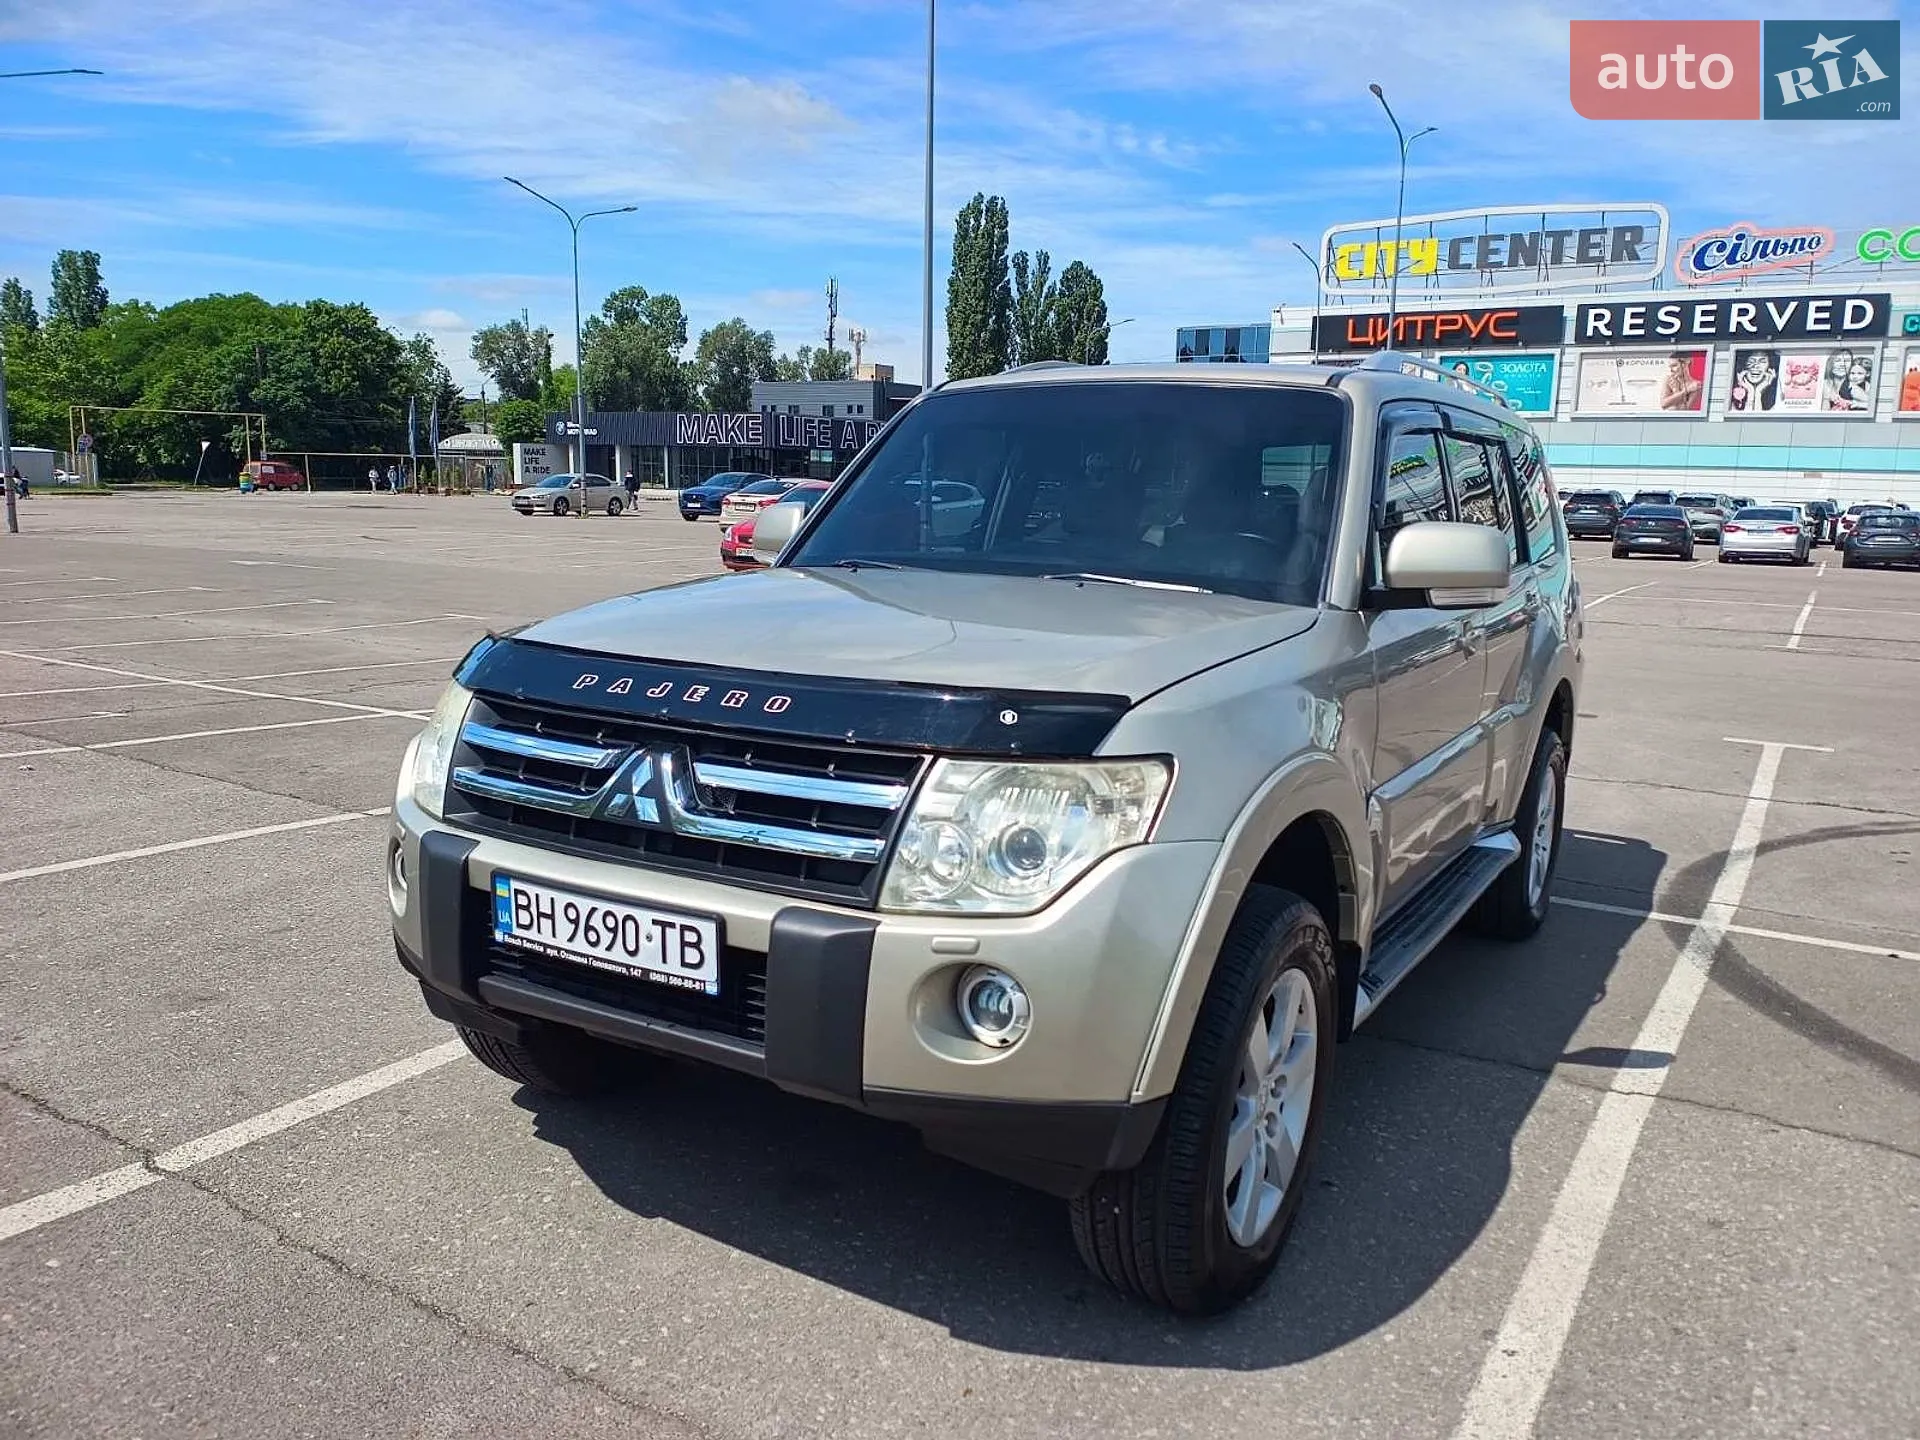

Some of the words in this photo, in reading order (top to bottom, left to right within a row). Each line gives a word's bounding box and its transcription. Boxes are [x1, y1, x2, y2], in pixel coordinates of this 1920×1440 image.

[1336, 238, 1439, 281] CITY
[1448, 225, 1644, 270] CENTER
[1691, 232, 1824, 273] Сільпо
[1347, 311, 1519, 346] ЦИТРУС
[1586, 299, 1875, 338] RESERVED
[676, 413, 763, 445] MAKE
[778, 415, 832, 448] LIFE
[840, 420, 859, 449] A
[524, 447, 546, 456] MAKE
[524, 457, 540, 465] LIFE
[572, 673, 793, 713] PAJERO
[498, 912, 512, 926] UA
[514, 887, 557, 940] BH
[563, 901, 640, 958] 9690
[651, 919, 706, 971] TB
[523, 940, 545, 954] Service
